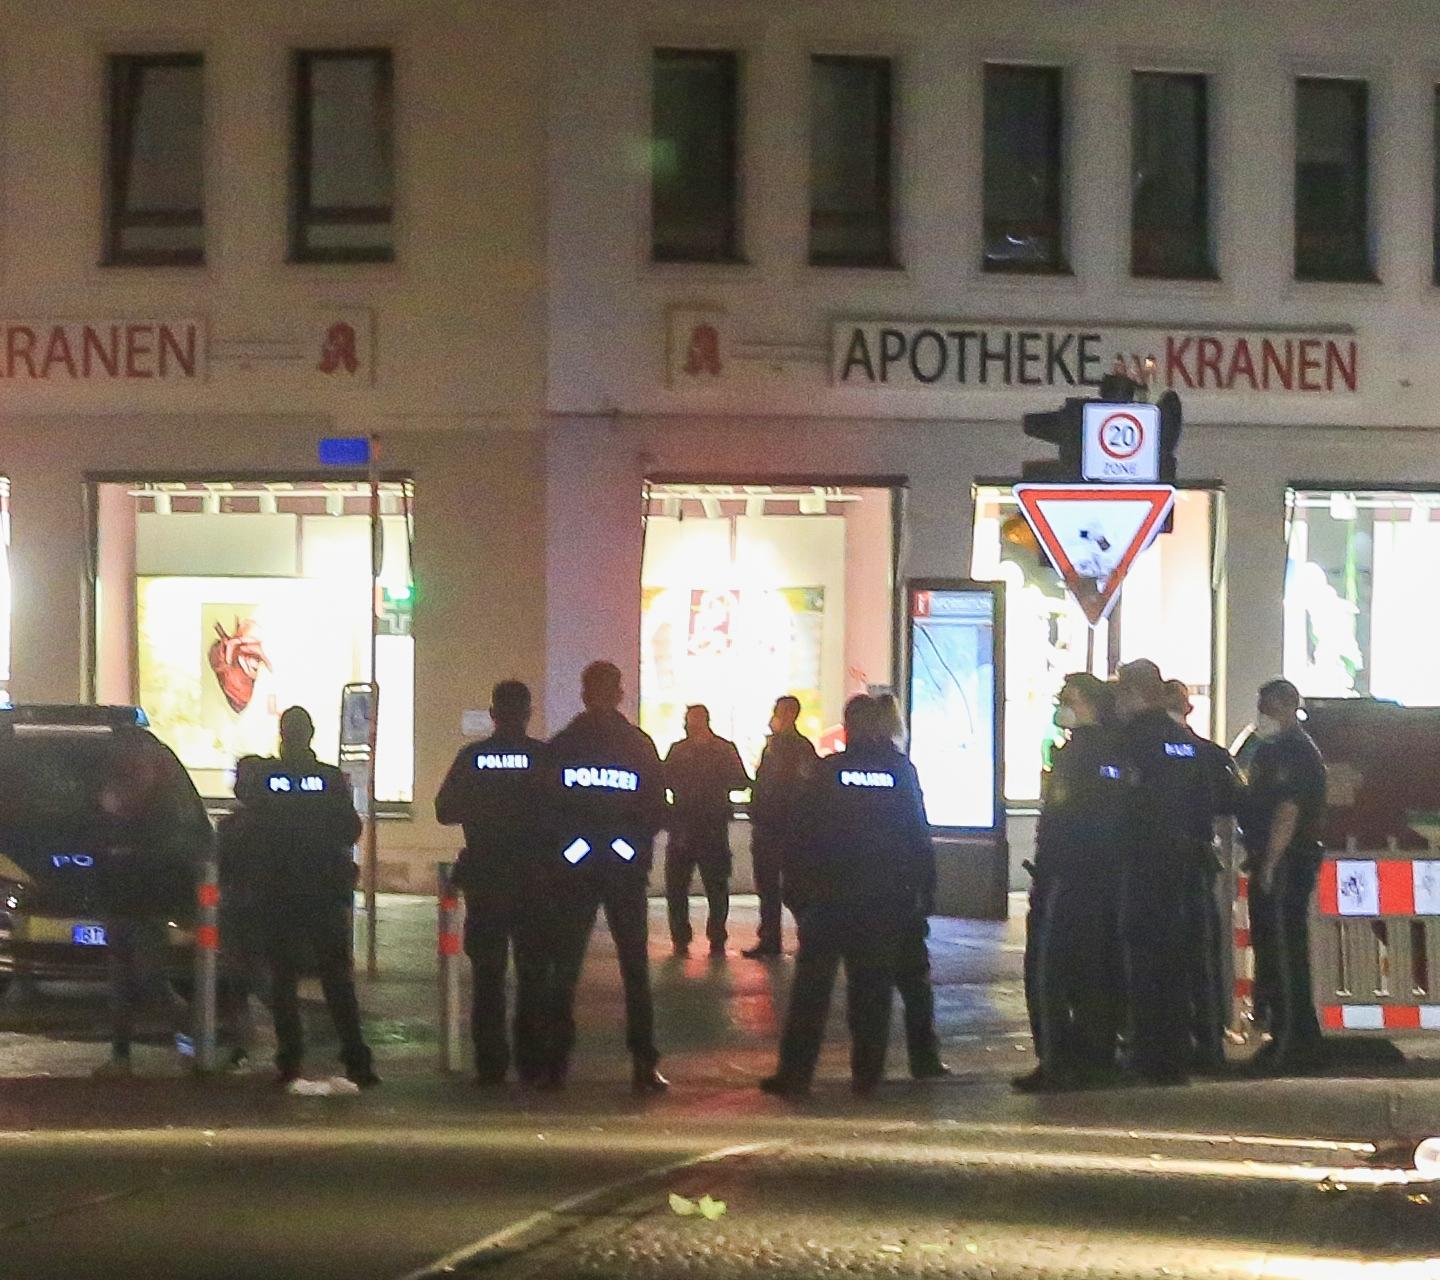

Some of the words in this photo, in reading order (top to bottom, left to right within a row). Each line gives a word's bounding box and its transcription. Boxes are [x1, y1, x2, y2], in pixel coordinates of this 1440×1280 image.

[843, 327, 1102, 387] APOTHEKE
[1165, 336, 1360, 391] KRANEN
[1108, 424, 1136, 447] 20
[1103, 462, 1137, 476] ZONE
[477, 754, 529, 770] POLIZEI
[564, 767, 638, 791] POLIZEI
[840, 770, 895, 788] POLIZEI
